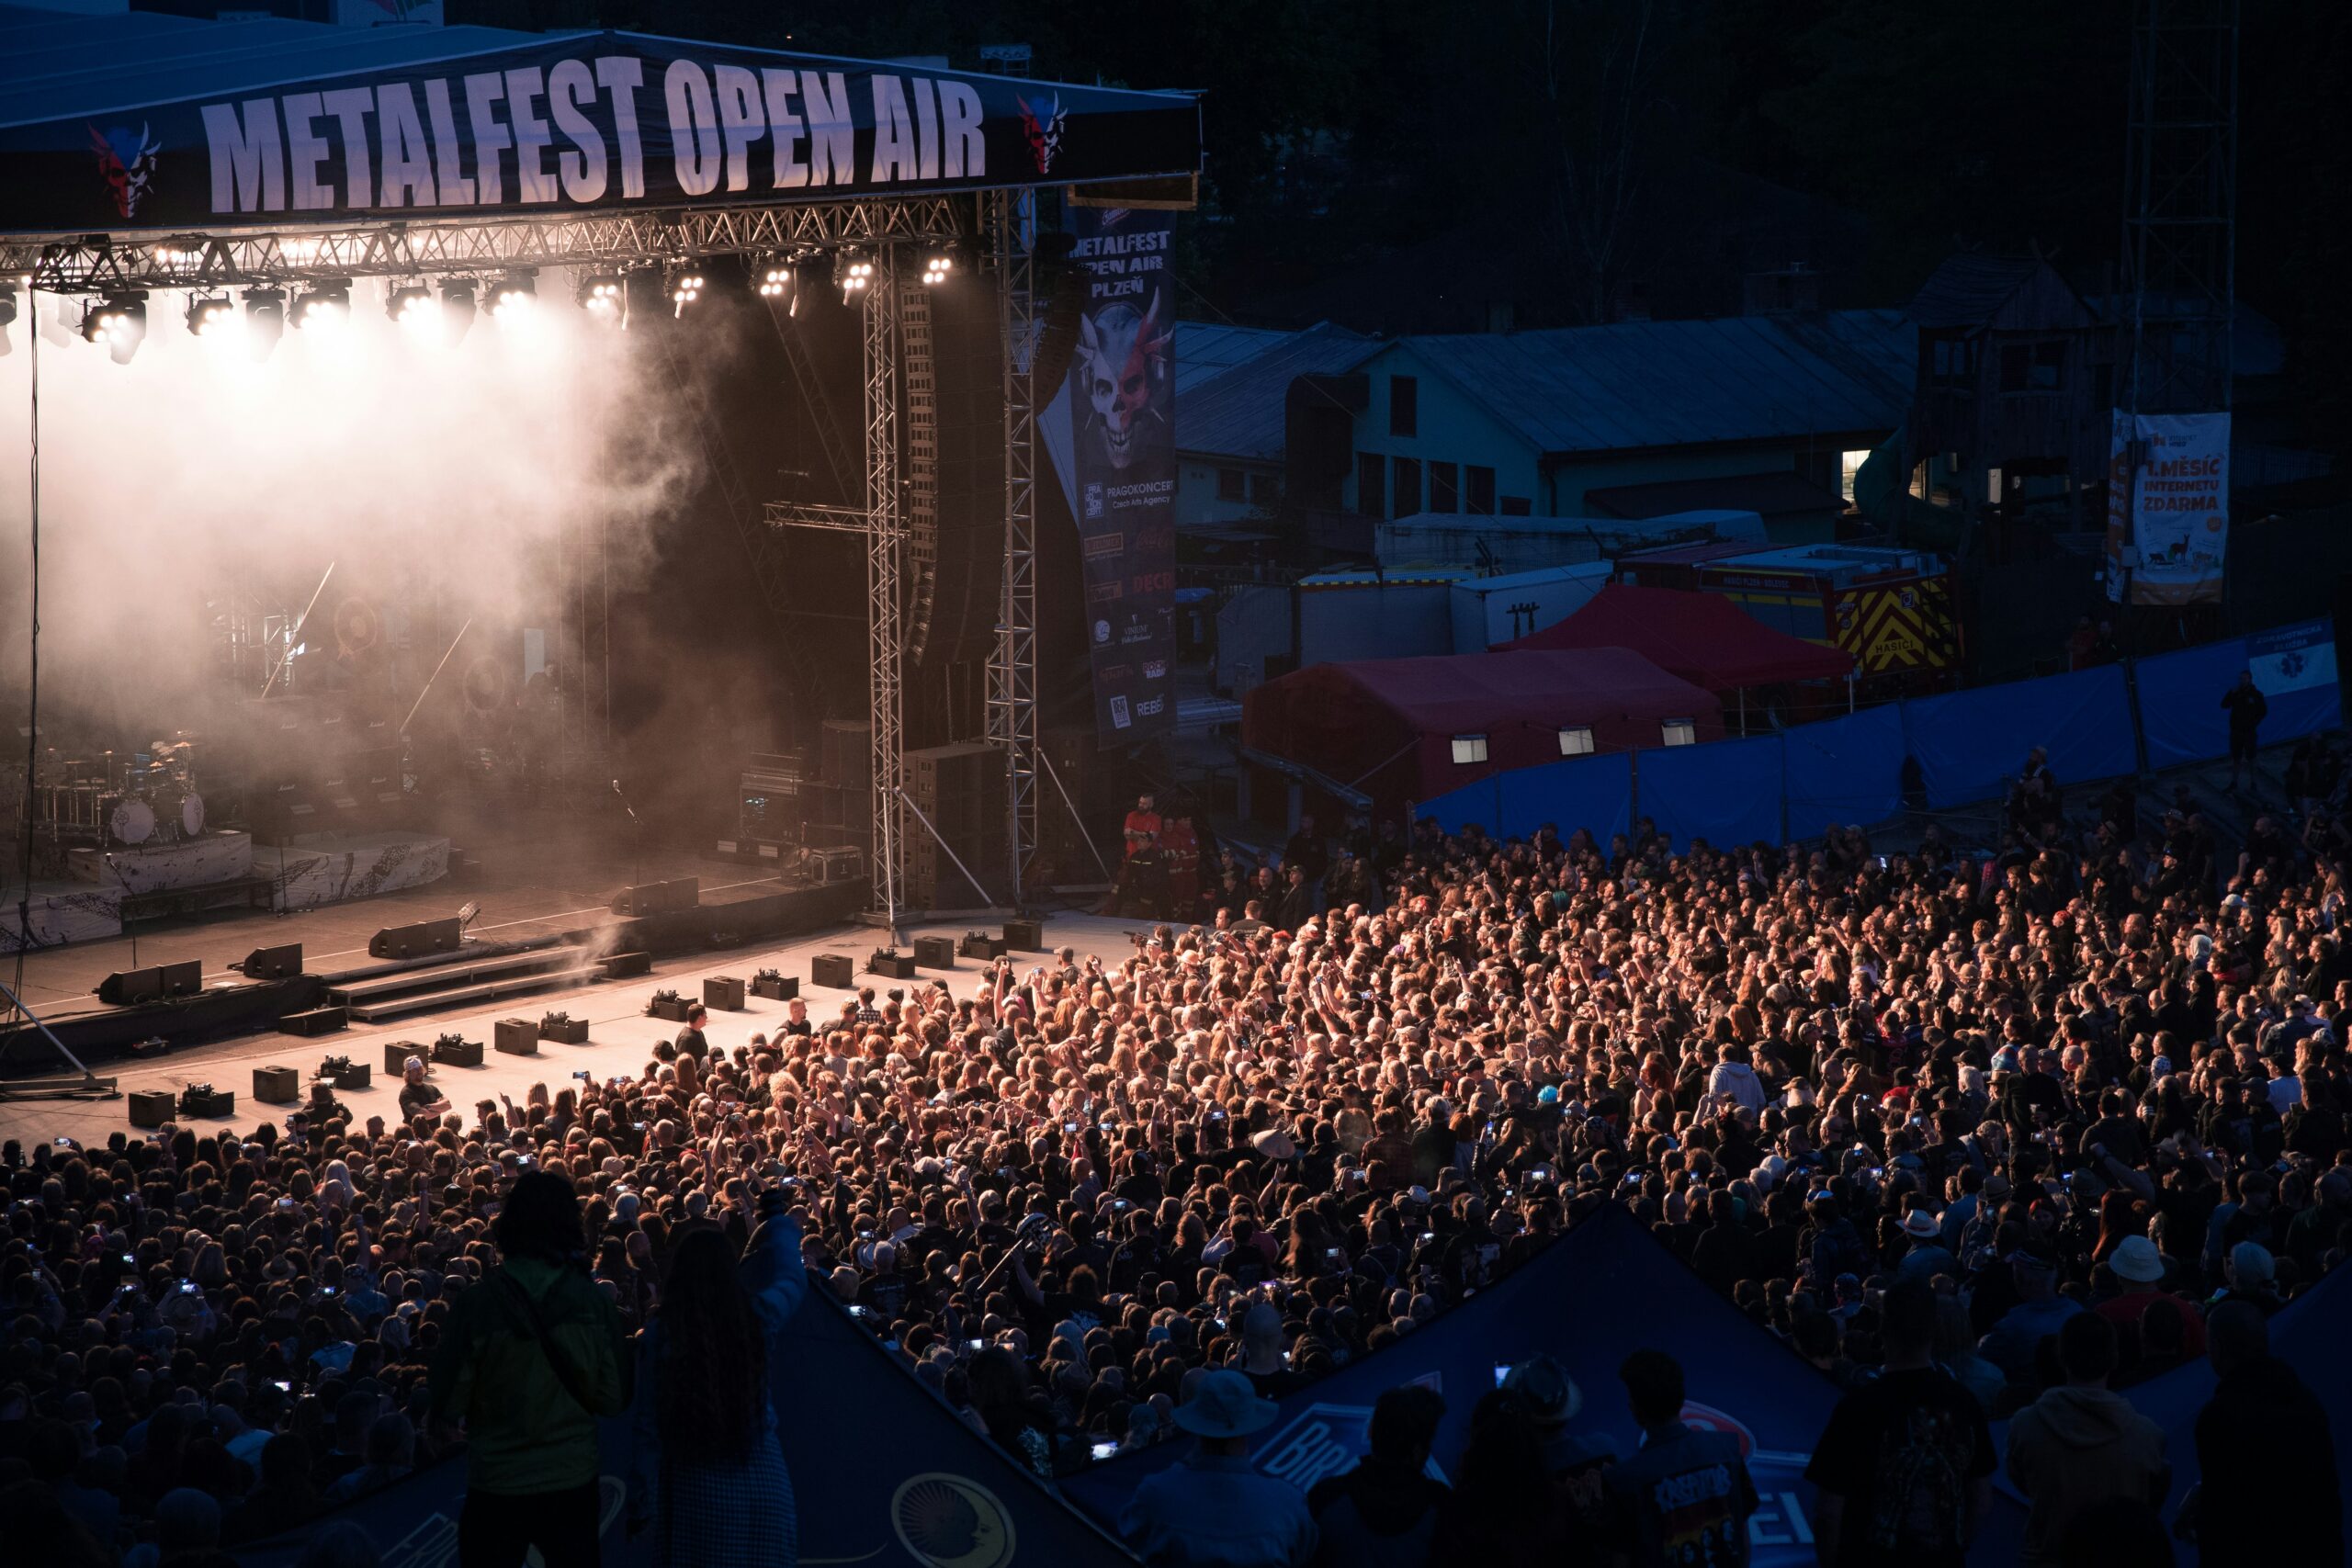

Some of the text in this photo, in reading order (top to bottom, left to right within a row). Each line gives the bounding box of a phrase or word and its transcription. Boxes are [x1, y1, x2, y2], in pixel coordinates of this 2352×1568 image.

[199, 55, 987, 214] METALFEST OPEN AIR
[1069, 230, 1170, 258] METALFEST
[1078, 255, 1164, 276] PEN AIR
[1091, 276, 1144, 298] PLZEŇ
[2161, 454, 2221, 477] MĚSÍC
[1106, 479, 1174, 498] PRAGOKONCERT
[2144, 479, 2221, 492] INTERNETU
[2143, 496, 2219, 512] ZDARMA
